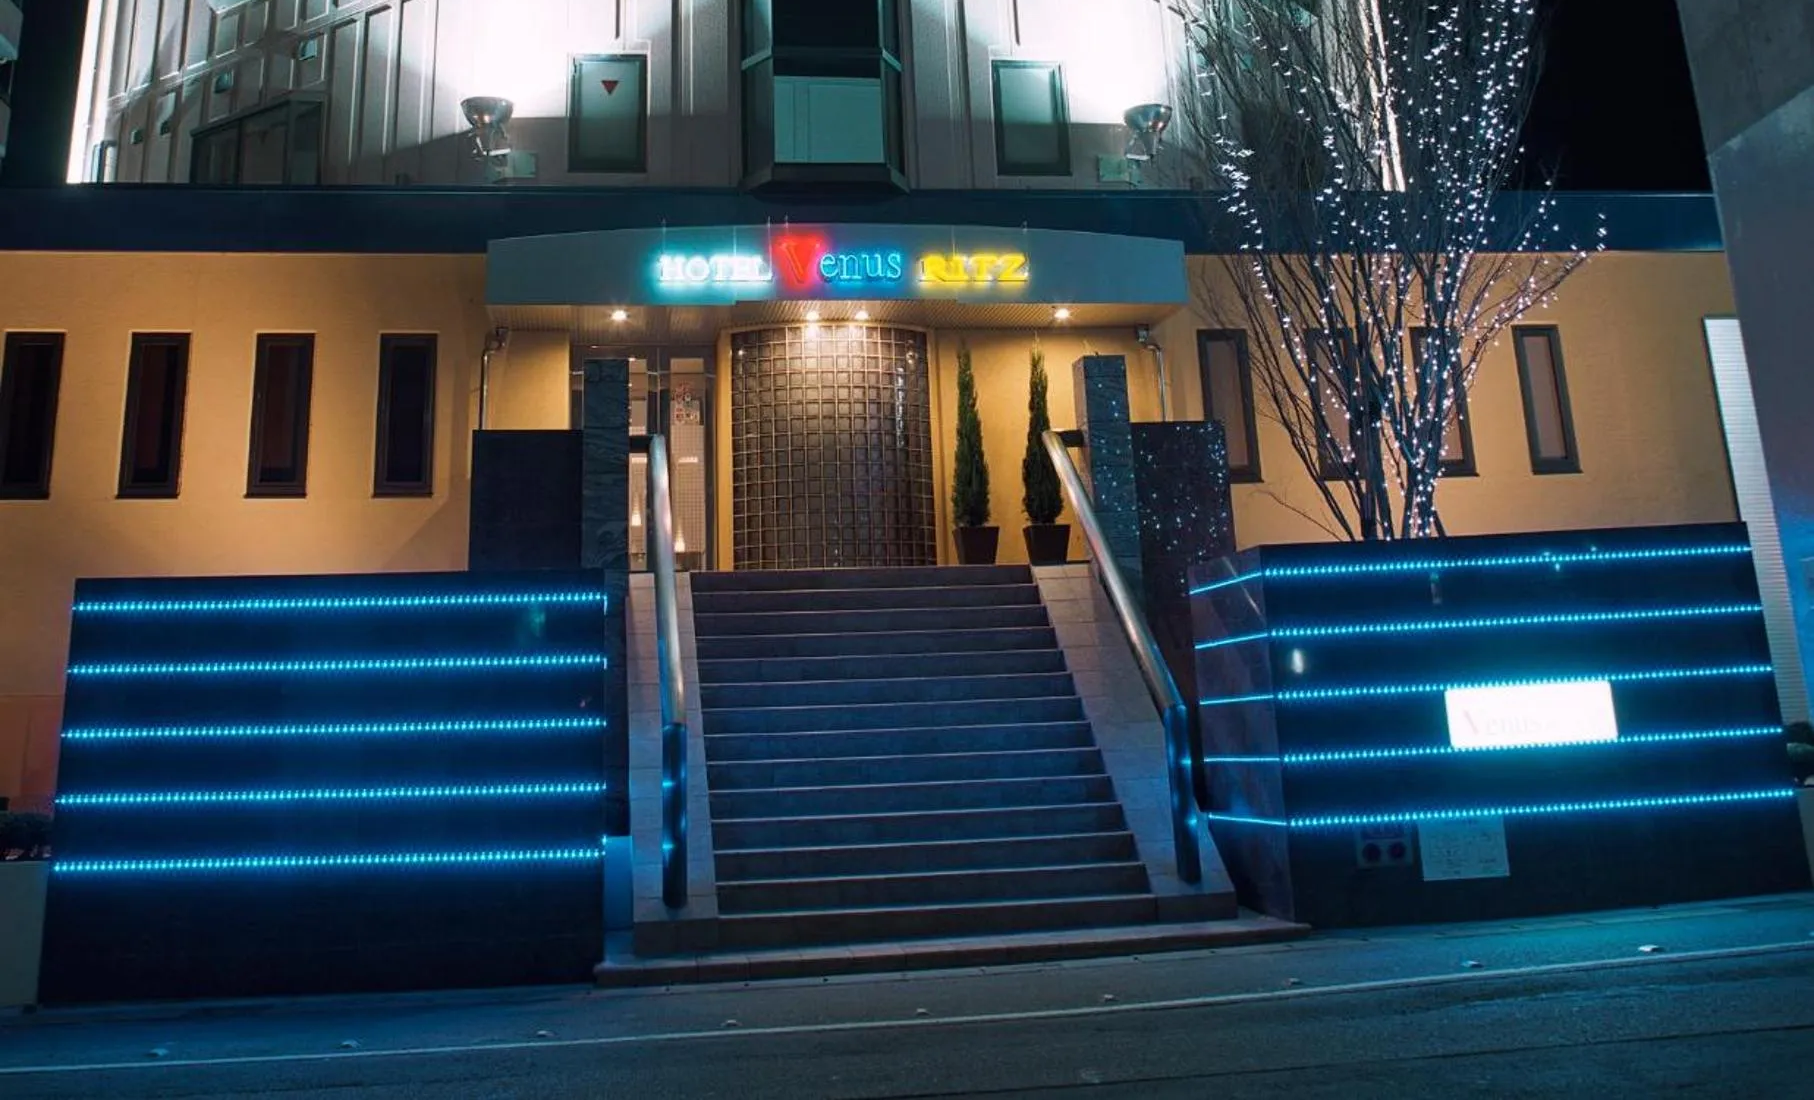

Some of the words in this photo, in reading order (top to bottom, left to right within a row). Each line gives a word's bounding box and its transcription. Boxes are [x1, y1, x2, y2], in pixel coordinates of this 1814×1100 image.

[659, 253, 772, 282] HOTEL
[777, 235, 902, 285] Venus
[917, 253, 1028, 283] RITZ
